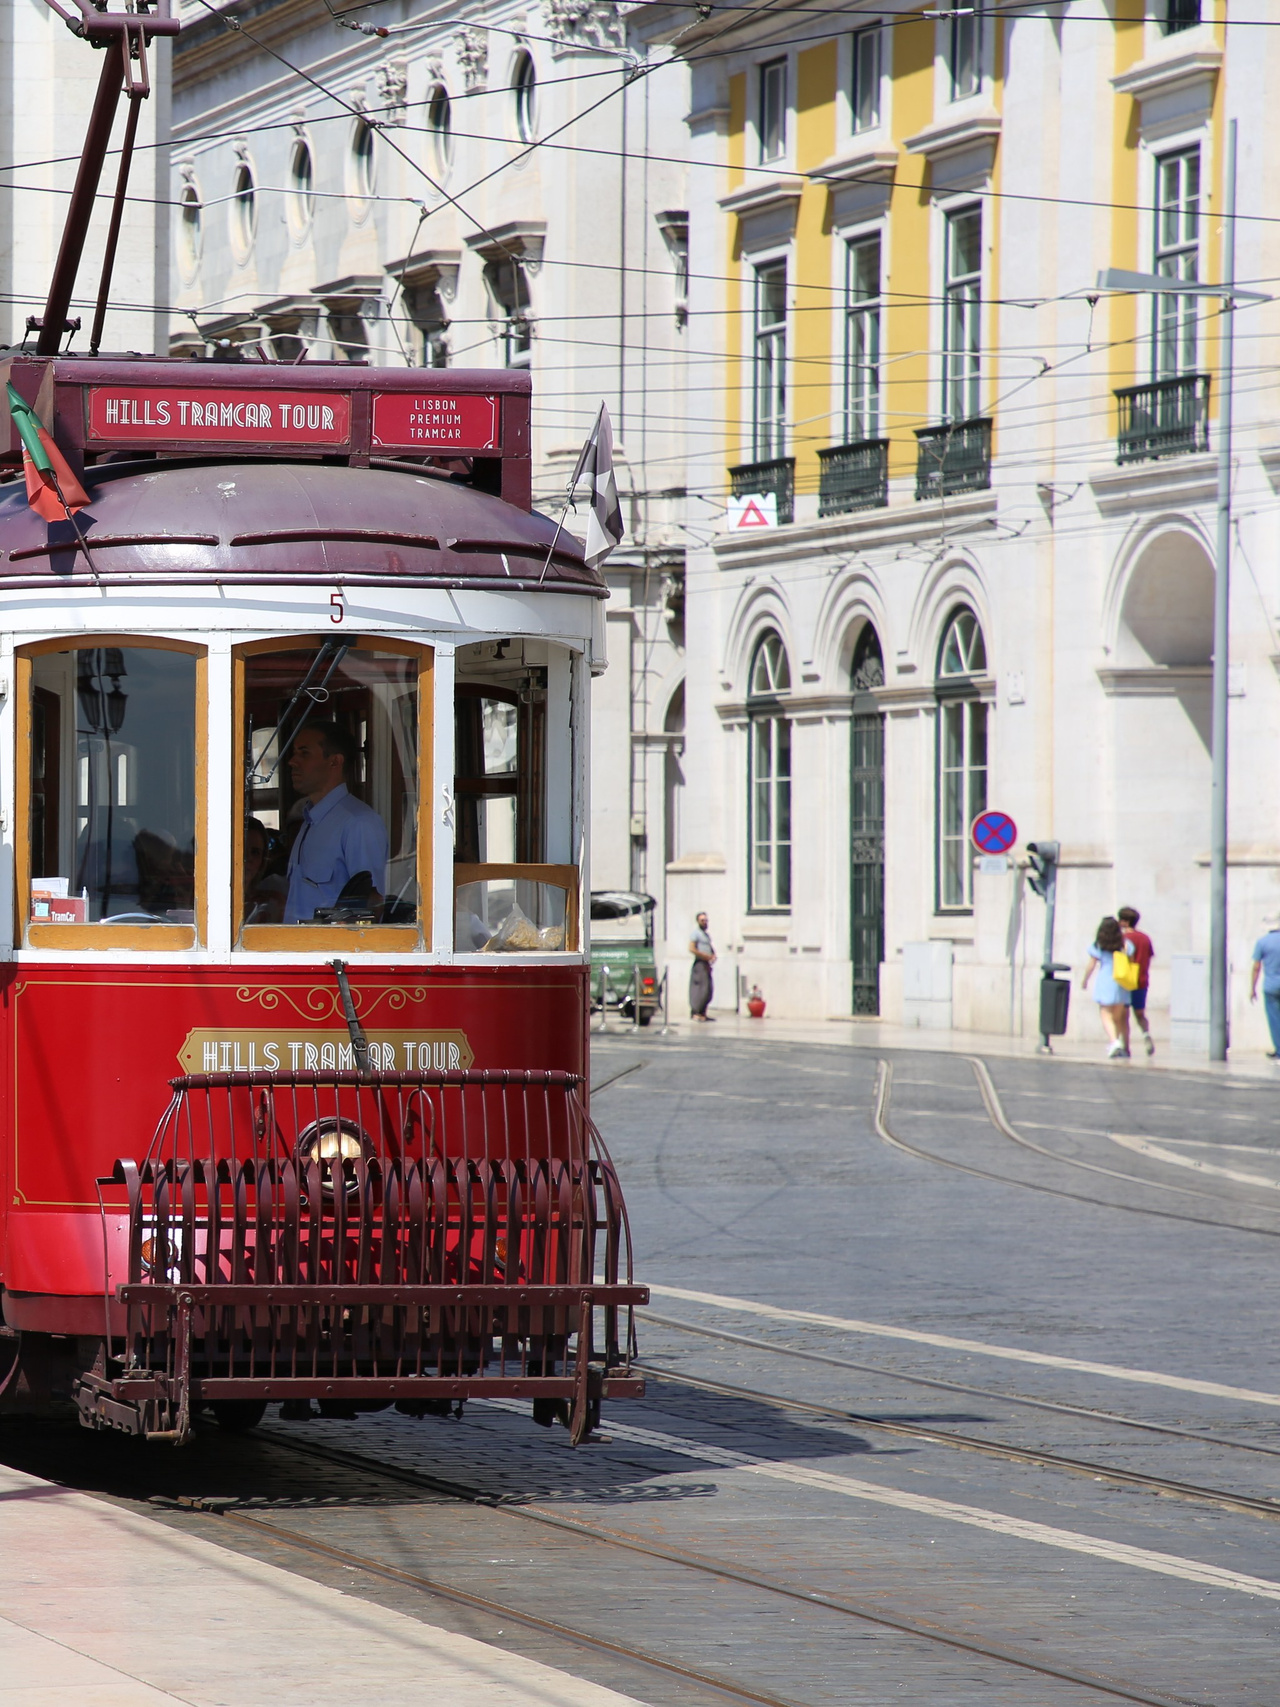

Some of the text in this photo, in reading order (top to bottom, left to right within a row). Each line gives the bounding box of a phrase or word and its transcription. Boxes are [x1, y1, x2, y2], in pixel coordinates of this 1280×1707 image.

[415, 400, 456, 410] LISBON
[106, 399, 334, 430] HILLS TRAMCAR TOUR
[410, 414, 461, 425] PREMIUM
[410, 428, 461, 439] TRAMCAR
[331, 594, 343, 623] 5
[51, 911, 76, 922] TramCar
[203, 1041, 460, 1072] HILLS TRAMAR TOUR
